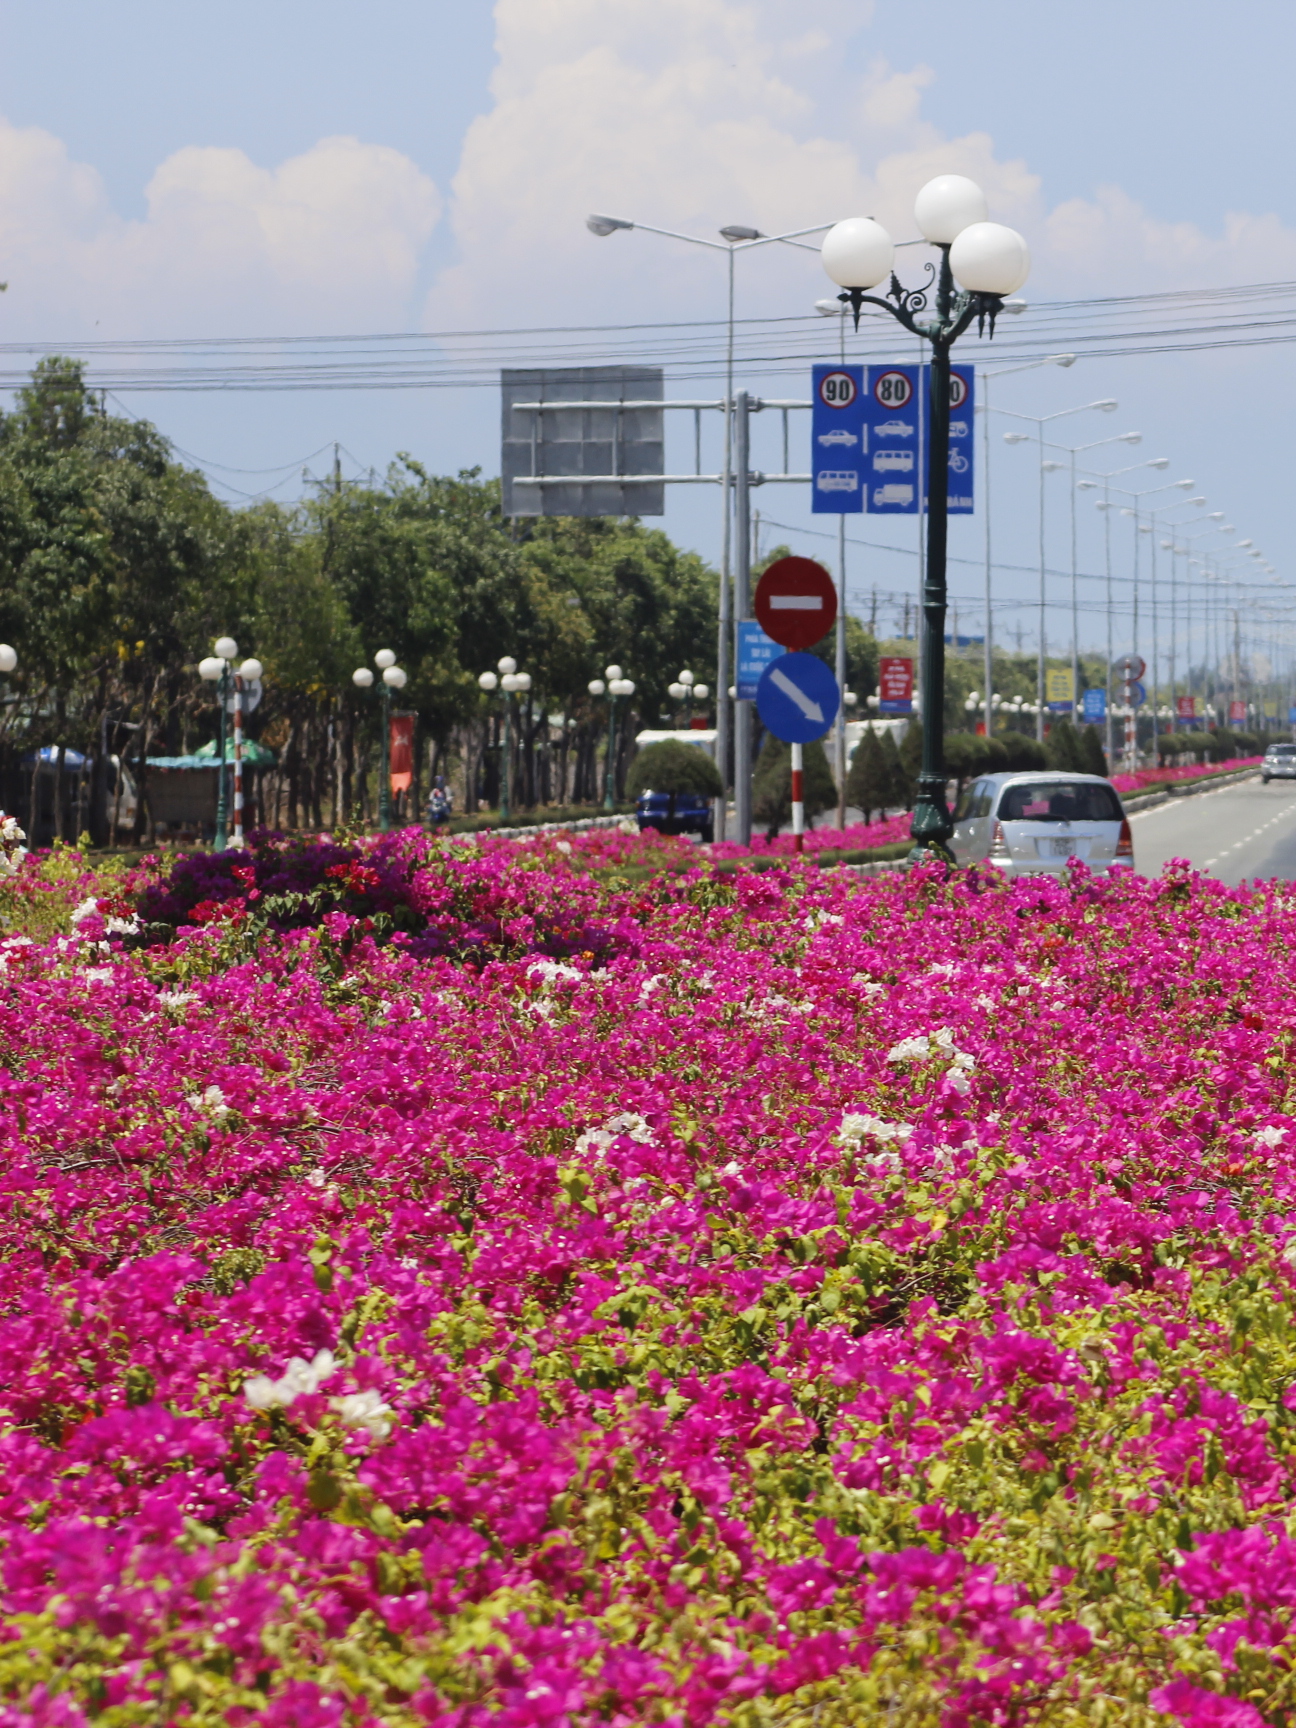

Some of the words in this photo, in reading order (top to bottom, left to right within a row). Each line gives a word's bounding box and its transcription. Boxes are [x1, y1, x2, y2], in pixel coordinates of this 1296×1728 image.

[826, 379, 850, 401] 90
[881, 379, 905, 401] 80
[949, 380, 960, 402] 0
